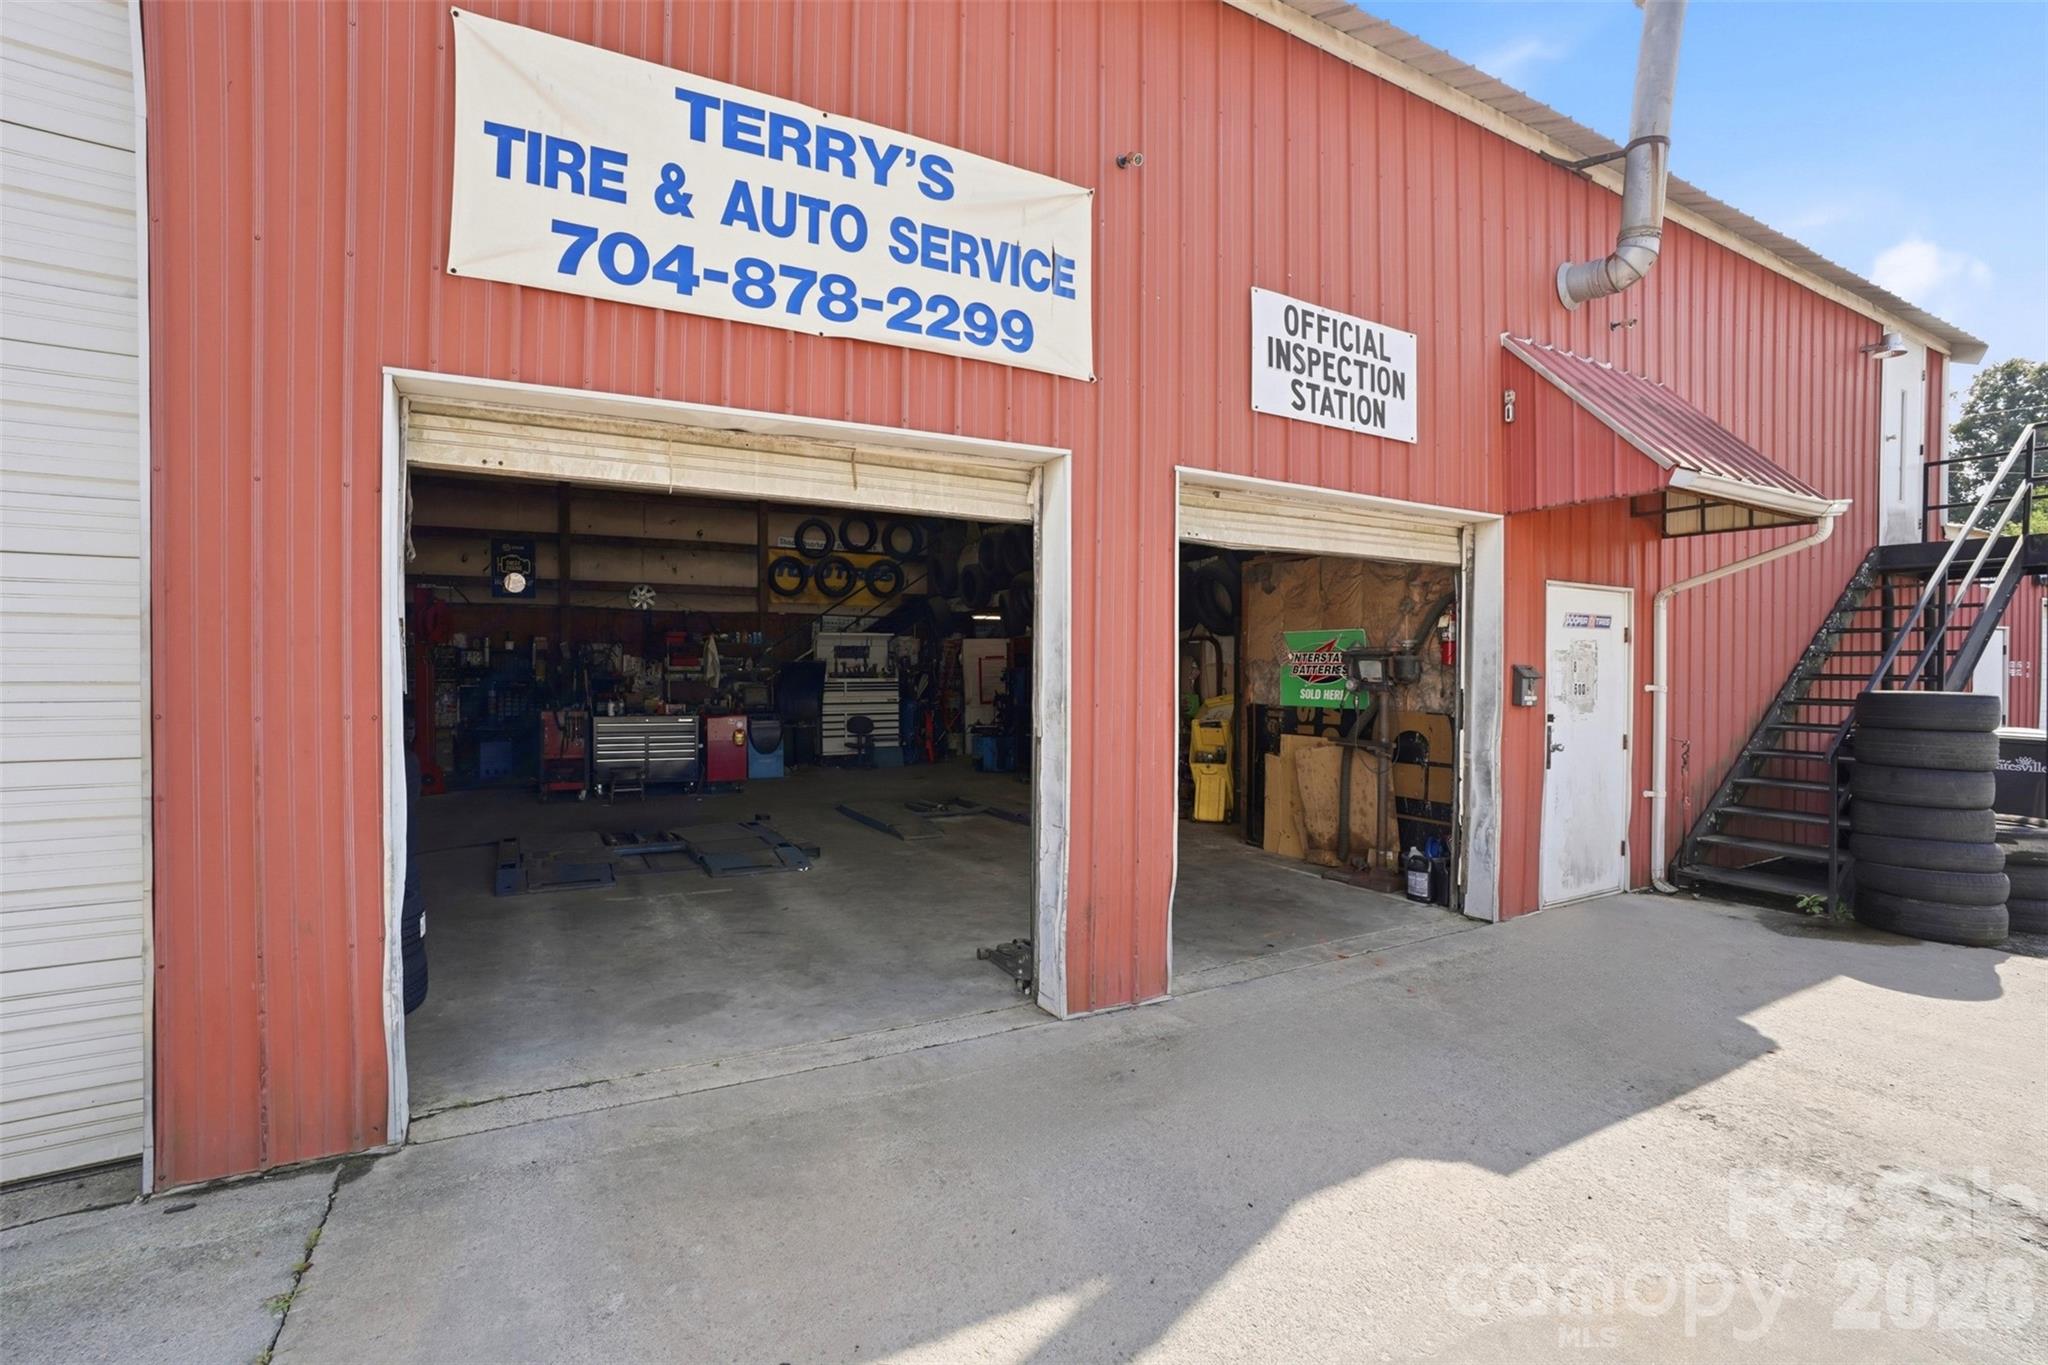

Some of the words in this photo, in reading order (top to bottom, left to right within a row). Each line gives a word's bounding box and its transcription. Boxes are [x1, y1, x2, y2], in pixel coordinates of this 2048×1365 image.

[675, 86, 955, 201] TERRY'S
[483, 120, 628, 204] TIRE
[654, 162, 695, 218] &
[721, 179, 868, 253] AUTO
[888, 216, 1076, 299] SERVICE
[551, 219, 1034, 353] 704-878-2299
[1284, 304, 1391, 363] OFFICIAL
[1267, 336, 1406, 400] INSPECTION
[1291, 378, 1386, 429] STATION
[1291, 652, 1343, 662] NTERSTA
[1300, 688, 1321, 700] SOLD
